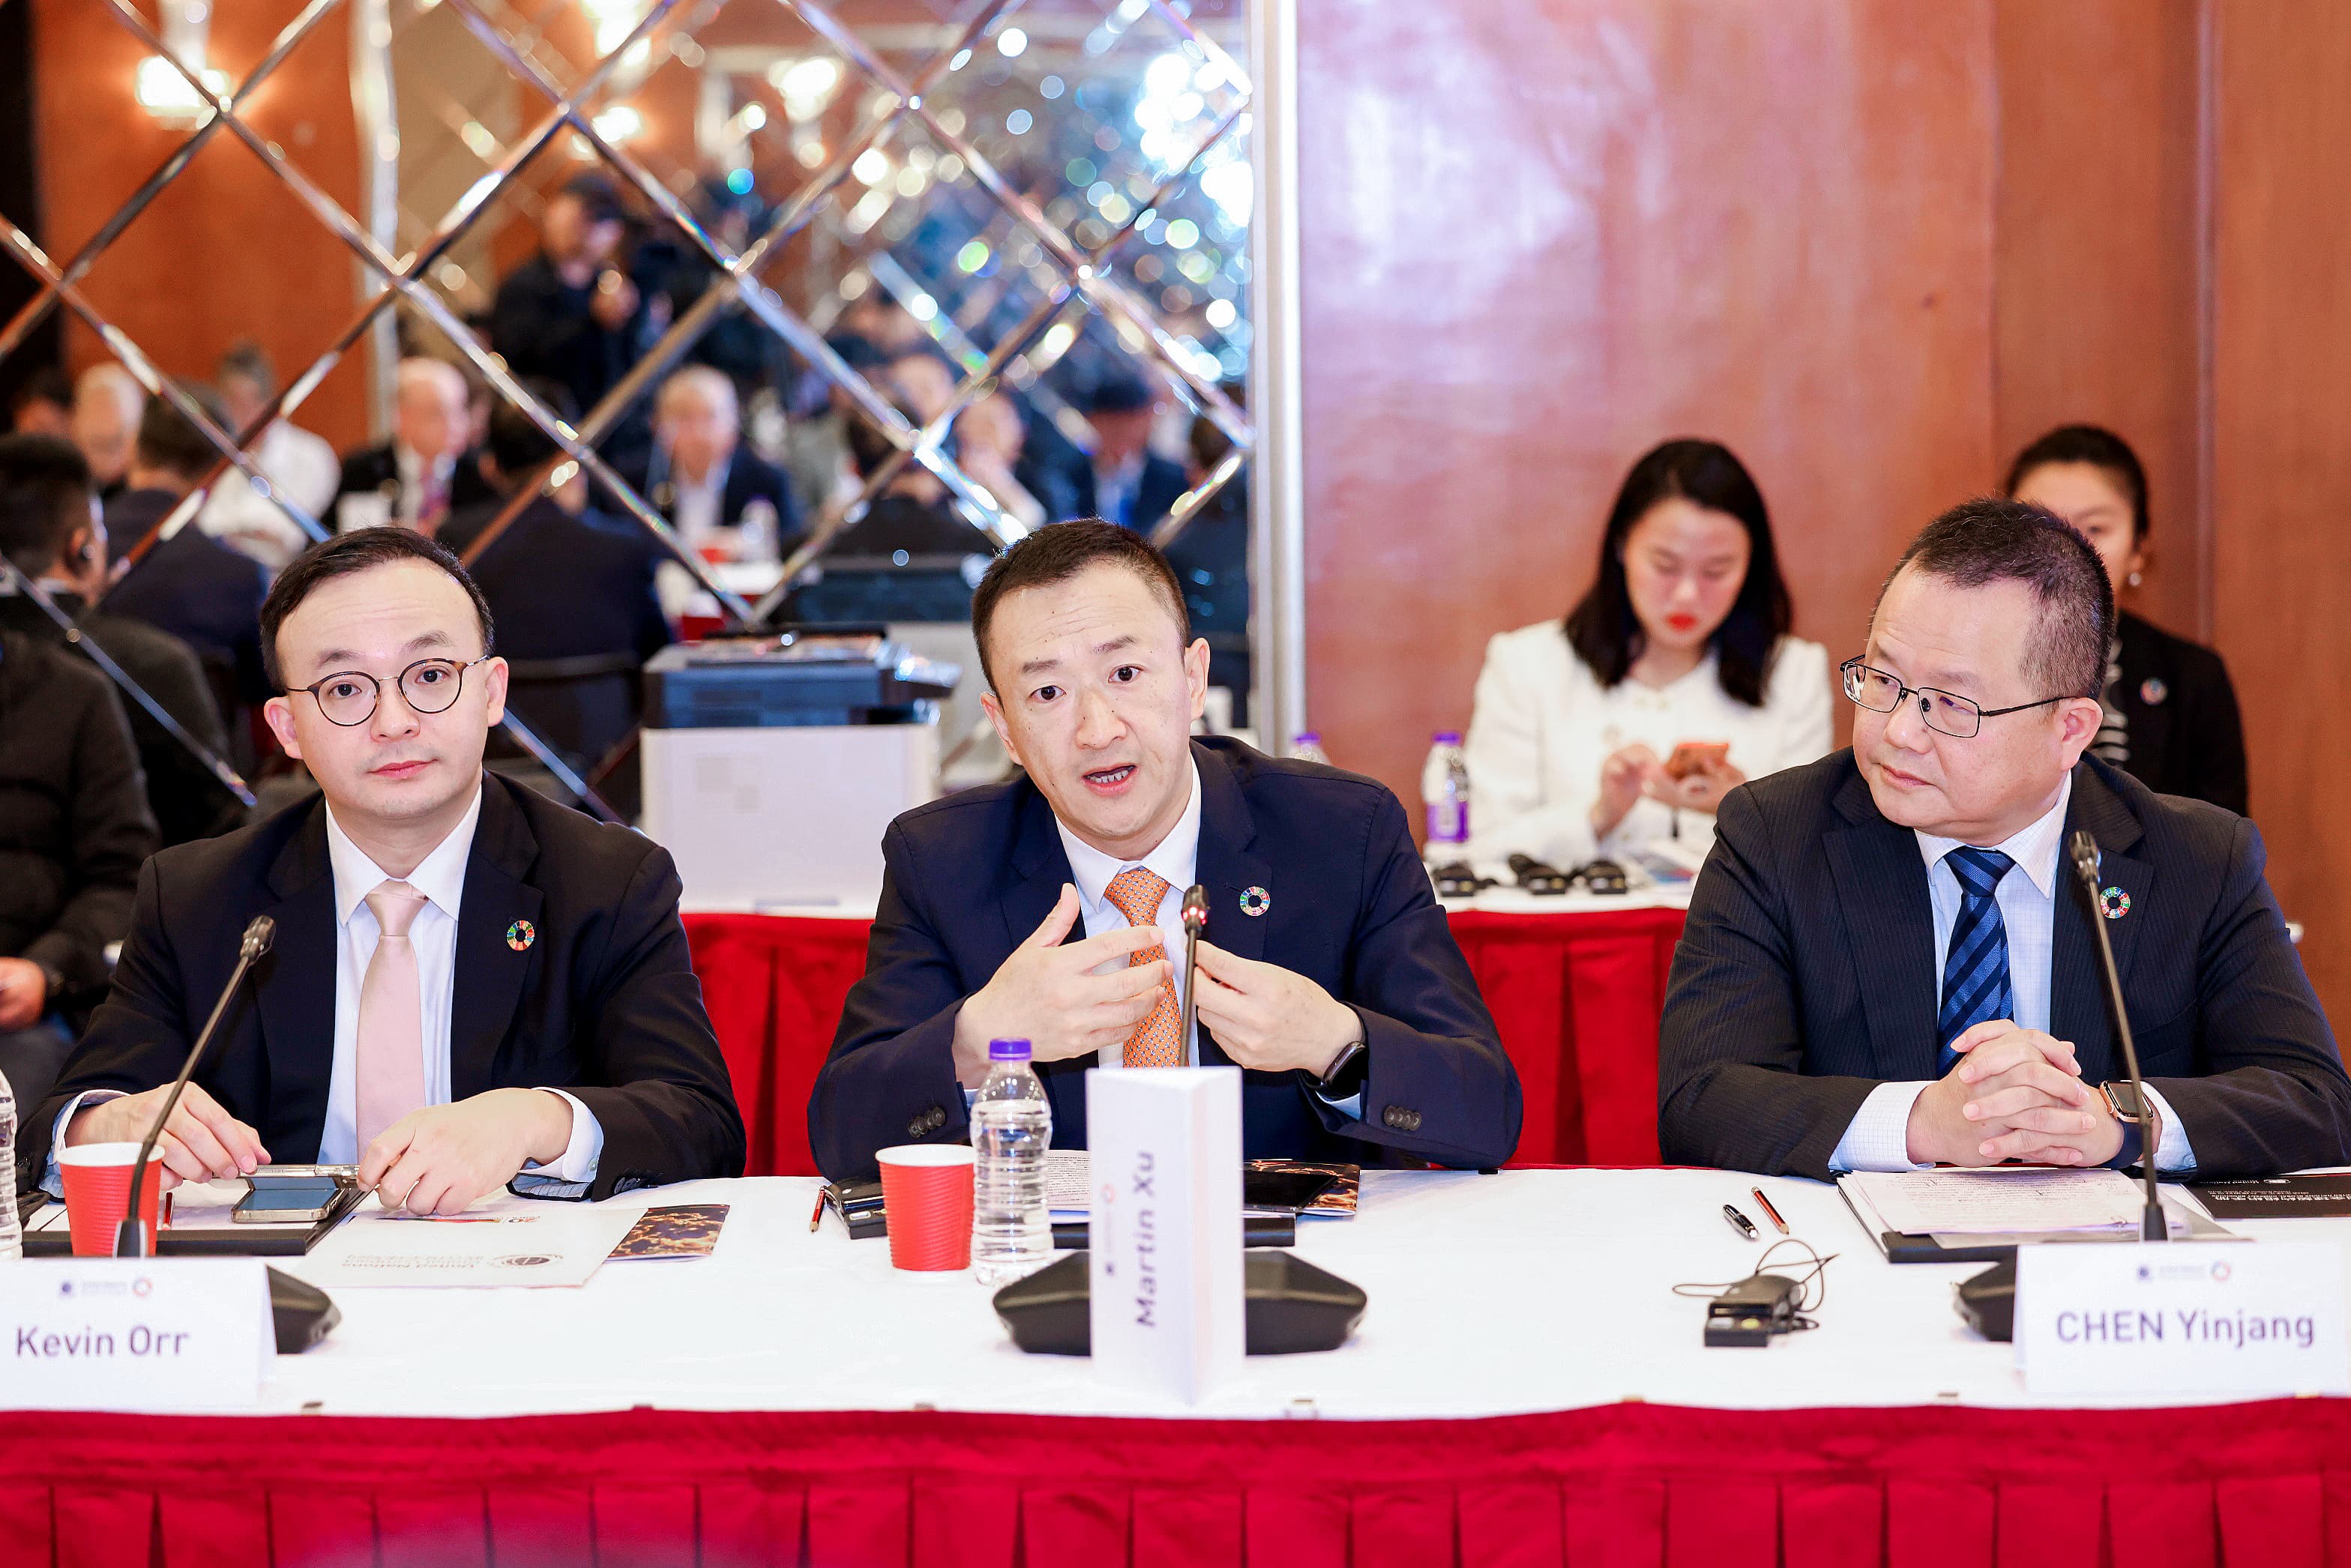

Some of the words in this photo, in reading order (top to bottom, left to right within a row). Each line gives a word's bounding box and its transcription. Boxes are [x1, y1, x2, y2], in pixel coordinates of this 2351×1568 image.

[1133, 1151, 1155, 1197] Xu
[1133, 1208, 1157, 1328] Martin
[16, 1326, 114, 1357] Kevin
[128, 1325, 188, 1356] Orr
[2056, 1311, 2164, 1342] CHEN
[2178, 1309, 2315, 1348] Yinjang
